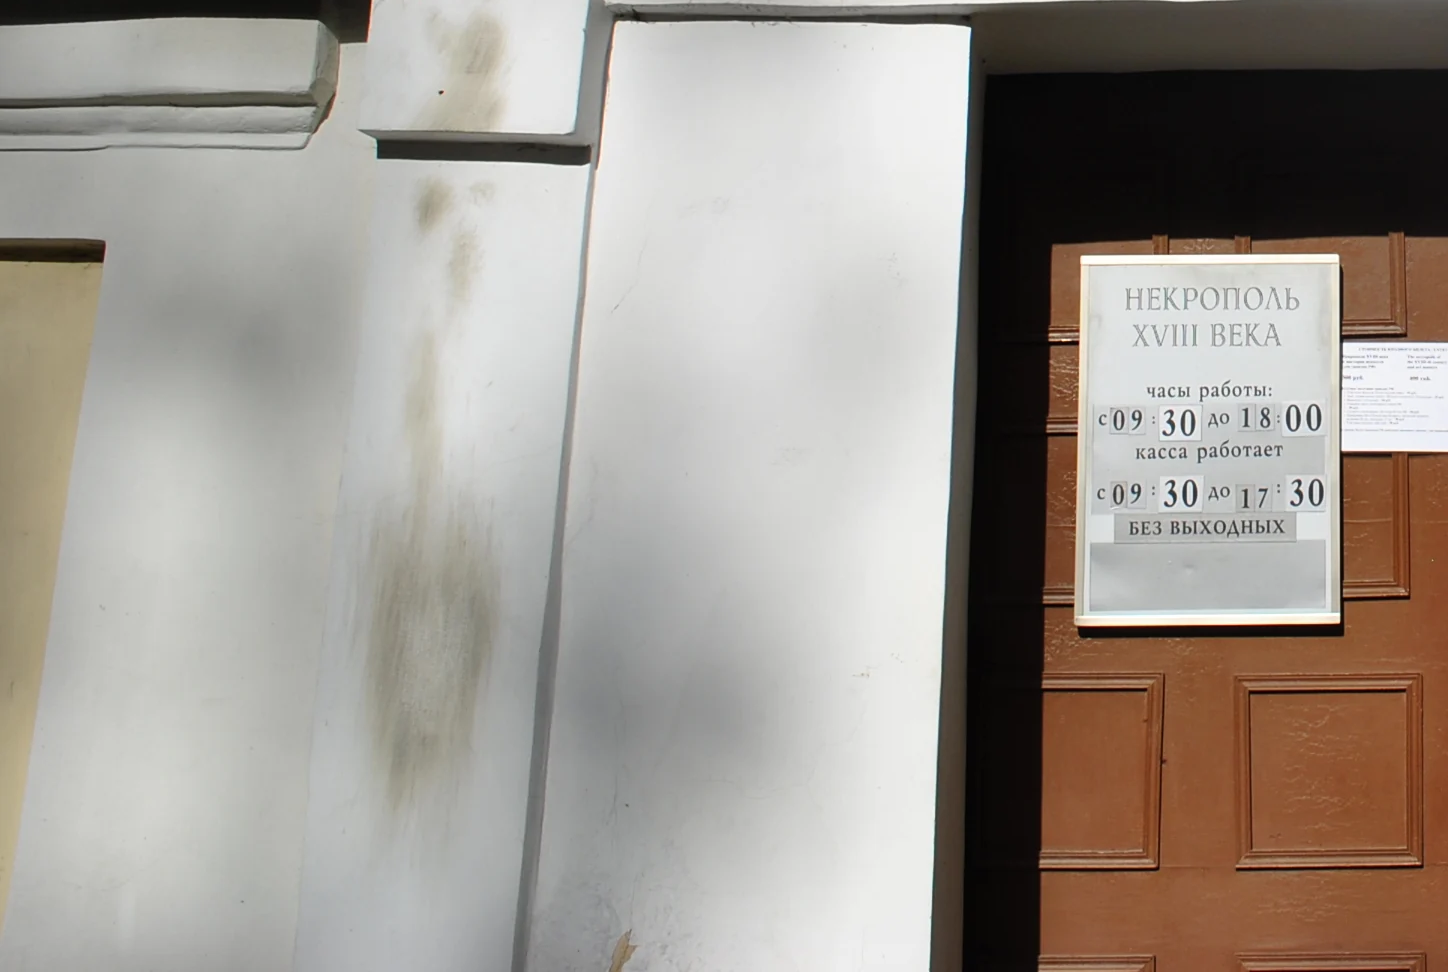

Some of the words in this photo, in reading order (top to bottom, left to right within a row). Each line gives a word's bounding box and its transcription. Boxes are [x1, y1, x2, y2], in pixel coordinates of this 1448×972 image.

[1125, 285, 1301, 311] НЕКРОПОЛЬ
[1132, 323, 1198, 347] XVIII
[1210, 322, 1282, 347] ВЕКА
[1146, 386, 1190, 398] часы
[1199, 379, 1273, 402] работы:
[1207, 412, 1230, 428] до
[1135, 447, 1188, 460] касса
[1197, 439, 1284, 464] работает
[1207, 486, 1231, 501] до
[1129, 520, 1163, 536] БЕЗ
[1170, 519, 1286, 538] ВЫХОДНЫХ
